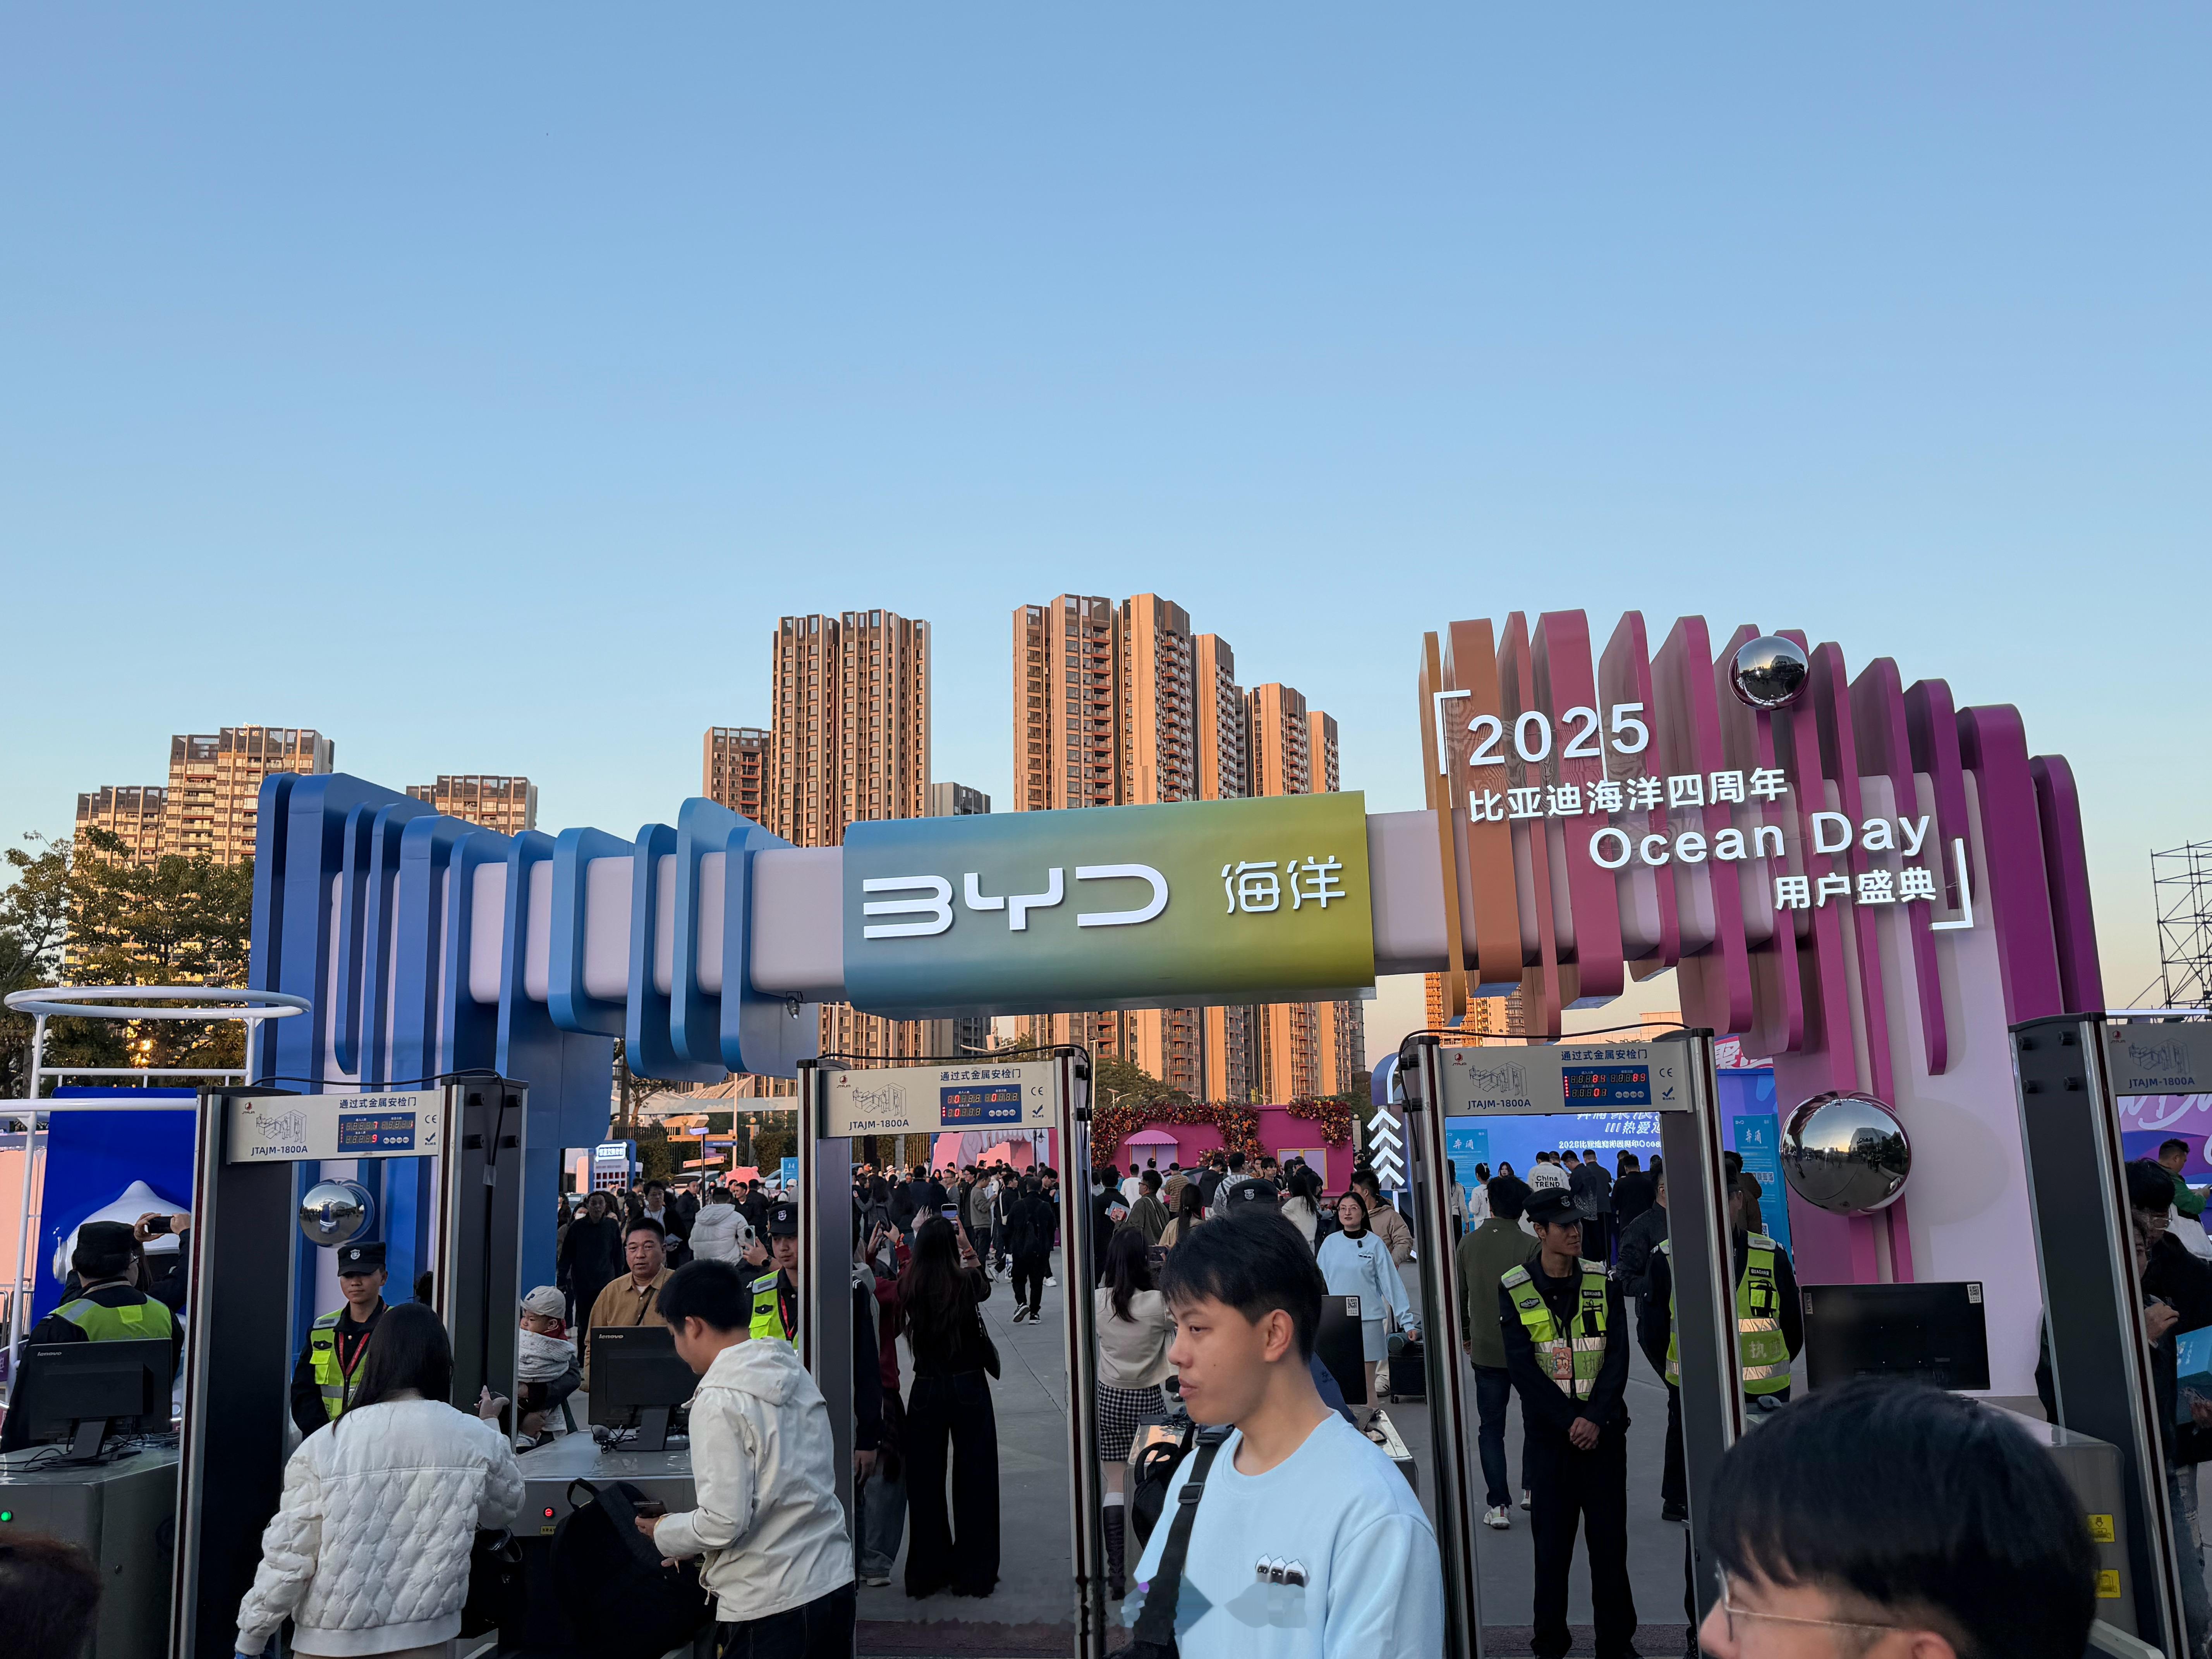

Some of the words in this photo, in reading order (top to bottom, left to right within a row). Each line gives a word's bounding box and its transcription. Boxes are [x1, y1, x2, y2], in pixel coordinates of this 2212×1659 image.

[1468, 702, 1650, 766] 2025
[1469, 767, 1789, 824] 比亚迪海洋四周年
[1589, 824, 1785, 869] Ocean
[1812, 811, 1930, 857] Day
[1773, 866, 1936, 910] 用户盛典
[863, 863, 1169, 939] BYD
[1221, 855, 1345, 914] 海洋
[1561, 1049, 1648, 1061] 通过式金属安检门
[940, 1068, 1021, 1081] 通过式金属安检门
[1659, 1068, 1673, 1077] CE
[2129, 1077, 2195, 1089] JTAJM-1800A
[1031, 1087, 1044, 1096] CE
[339, 1097, 416, 1109] 通过式金属安检门
[1467, 1099, 1531, 1110] JTAJM-1800A
[425, 1115, 437, 1123] CE
[849, 1119, 909, 1130] JTAJM-1800A
[251, 1146, 307, 1156] JTAJM-1800A
